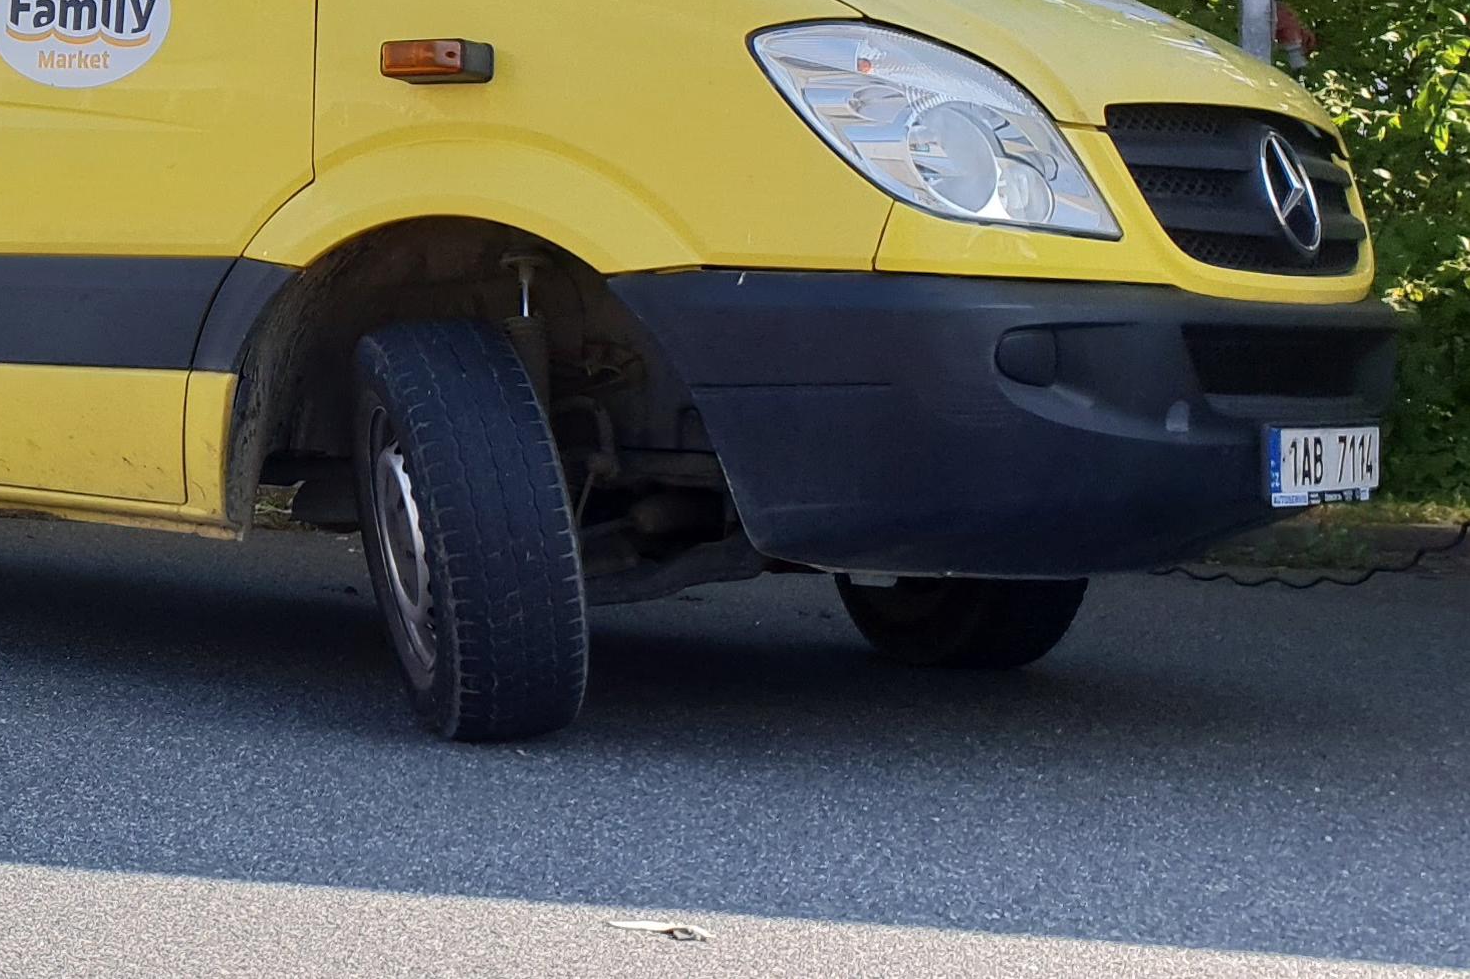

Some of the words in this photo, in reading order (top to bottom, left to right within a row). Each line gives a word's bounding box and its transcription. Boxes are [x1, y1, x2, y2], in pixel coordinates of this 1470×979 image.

[38, 50, 110, 69] Market
[1289, 436, 1324, 487] 1AB
[1338, 434, 1373, 483] 7114
